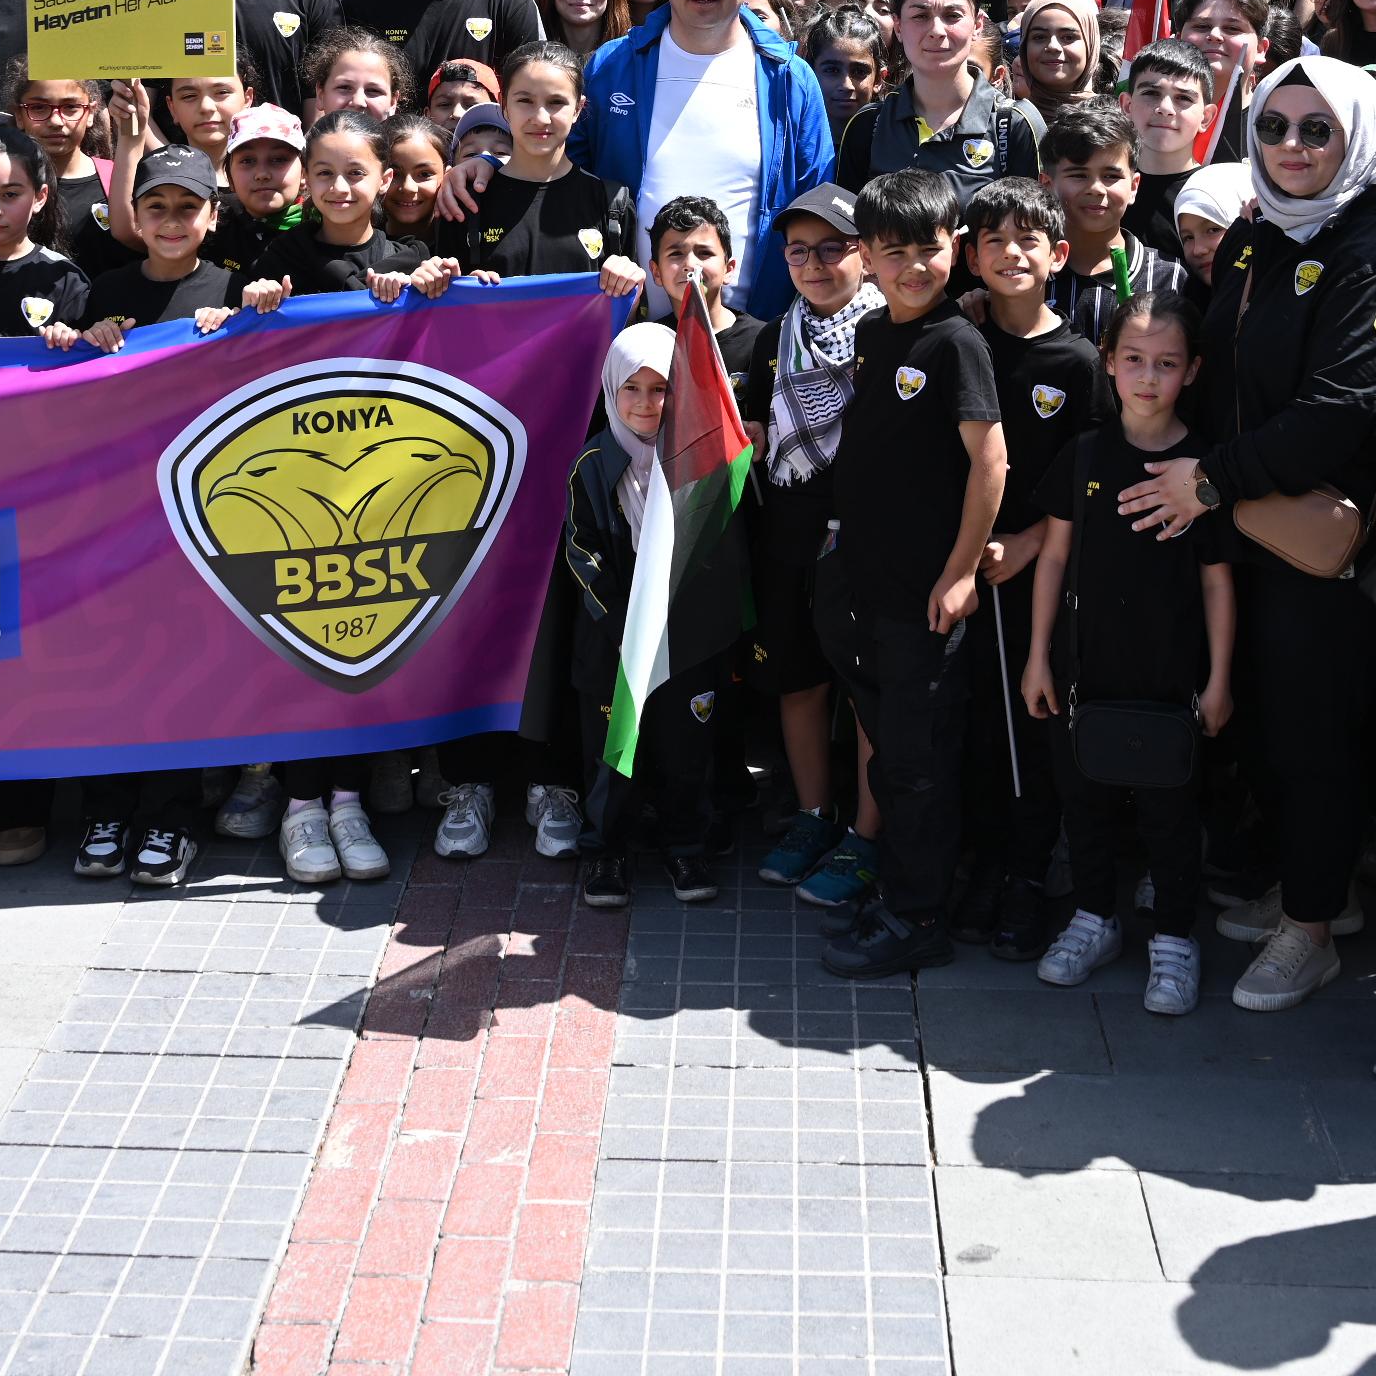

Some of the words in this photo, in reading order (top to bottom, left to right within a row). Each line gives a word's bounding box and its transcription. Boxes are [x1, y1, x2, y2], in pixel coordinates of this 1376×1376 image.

[34, 3, 111, 32] Hayatın
[292, 404, 395, 436] KONYA
[274, 542, 431, 606] BBSK
[321, 613, 379, 644] 1987
